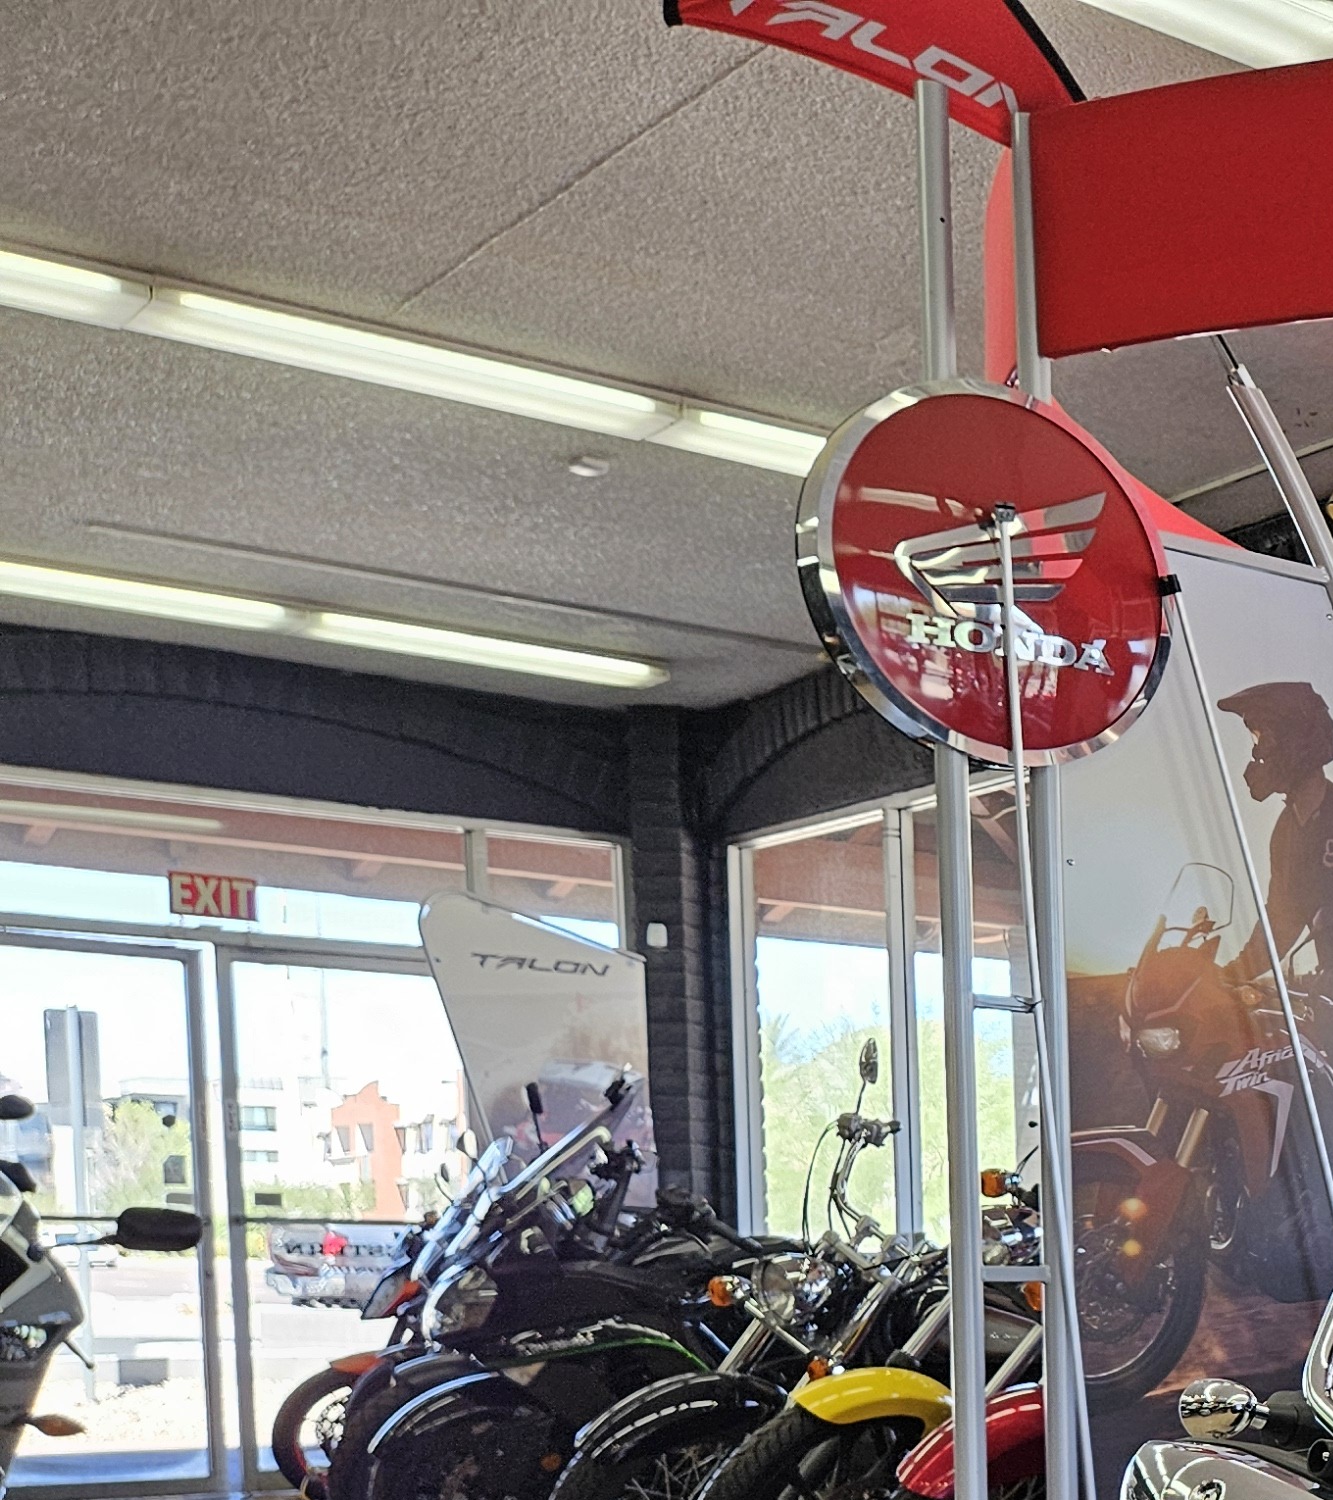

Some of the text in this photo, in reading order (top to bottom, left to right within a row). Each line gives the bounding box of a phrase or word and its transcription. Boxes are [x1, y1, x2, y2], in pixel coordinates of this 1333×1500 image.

[729, 0, 1018, 112] ALON
[906, 612, 1115, 677] HONDA
[170, 873, 256, 918] EXIT
[471, 952, 610, 977] TALON
